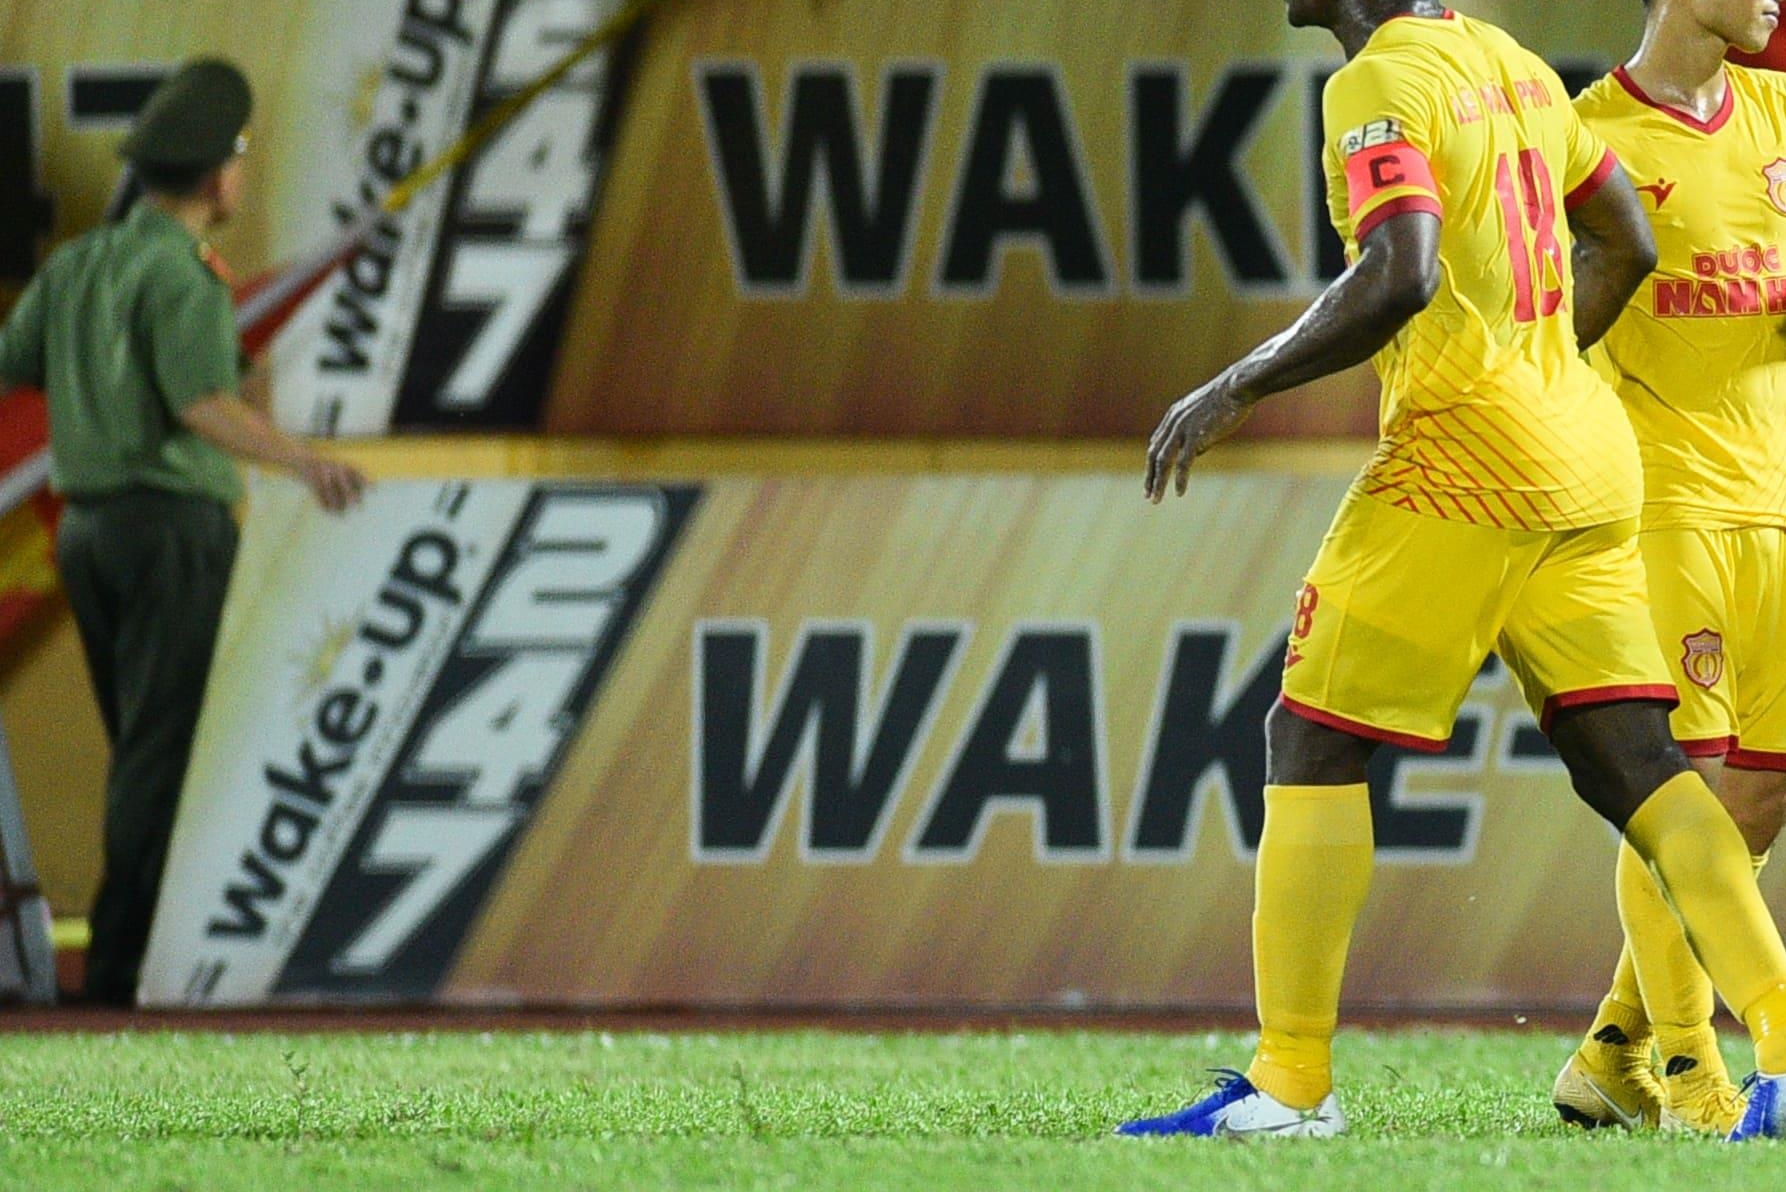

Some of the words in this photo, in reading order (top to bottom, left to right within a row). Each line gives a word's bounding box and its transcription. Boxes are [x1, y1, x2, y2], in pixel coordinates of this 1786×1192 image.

[1368, 154, 1405, 189] C
[1494, 146, 1566, 323] 18
[1653, 278, 1762, 319] NAM
[207, 528, 464, 946] wake-up
[329, 492, 669, 972] 247
